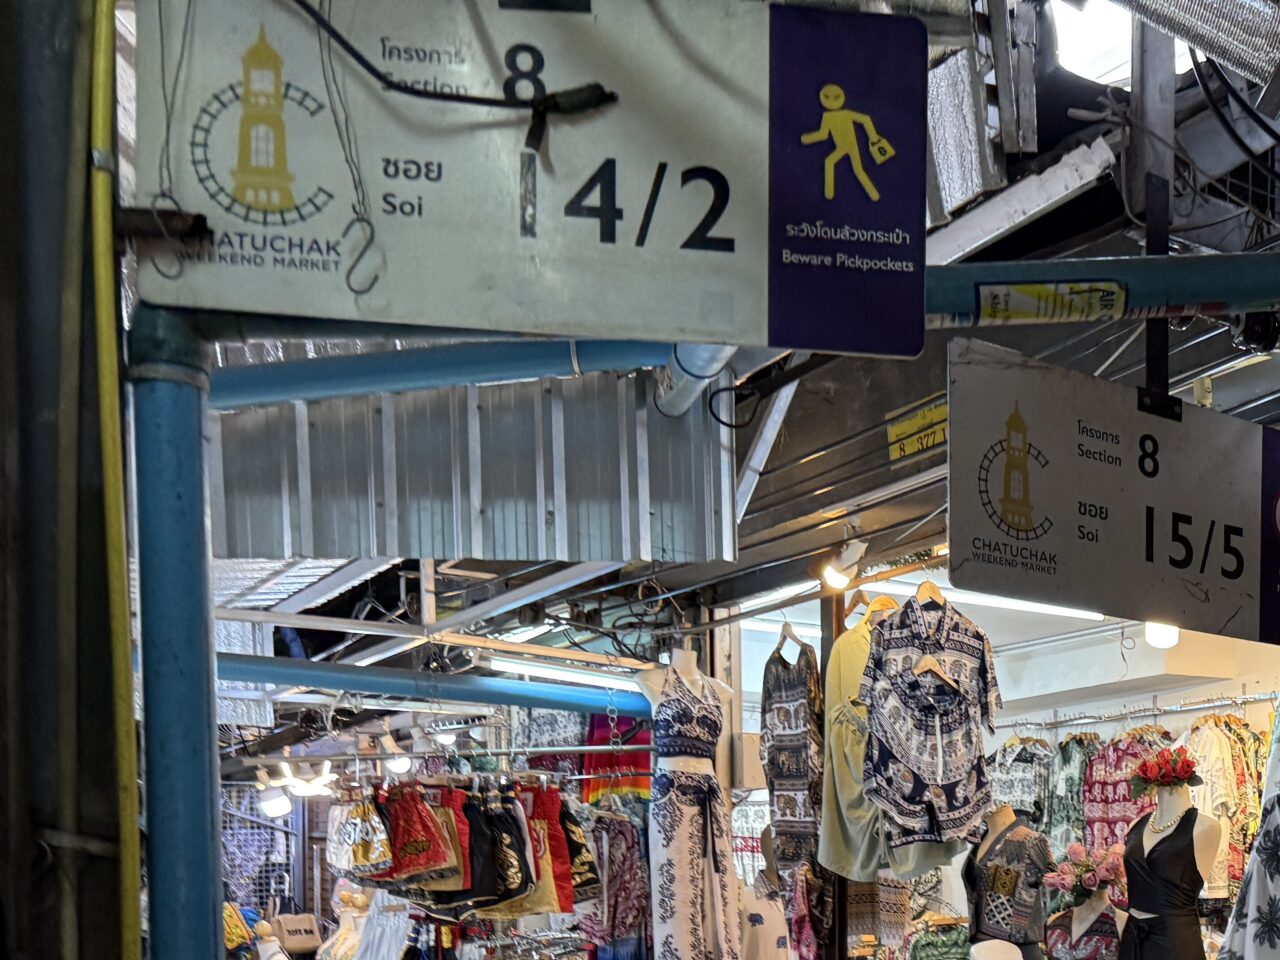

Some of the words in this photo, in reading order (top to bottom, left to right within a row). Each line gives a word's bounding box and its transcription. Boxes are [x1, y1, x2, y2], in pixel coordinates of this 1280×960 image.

[503, 43, 547, 105] 8
[382, 157, 443, 182] ซอย
[382, 193, 424, 218] Soi
[272, 256, 342, 272] MARKET
[782, 249, 832, 266] Beware
[836, 252, 915, 273] Pickpockets
[1077, 418, 1121, 446] โครงการ
[1077, 443, 1122, 467] Section
[1138, 433, 1160, 478] 8
[1077, 501, 1109, 521] ซอย
[1077, 525, 1099, 544] Soi
[1144, 505, 1245, 581] 15/5
[972, 537, 1058, 566] CHATUCHAK
[972, 551, 1018, 569] WEEKEND
[1021, 559, 1057, 576] MARKET
